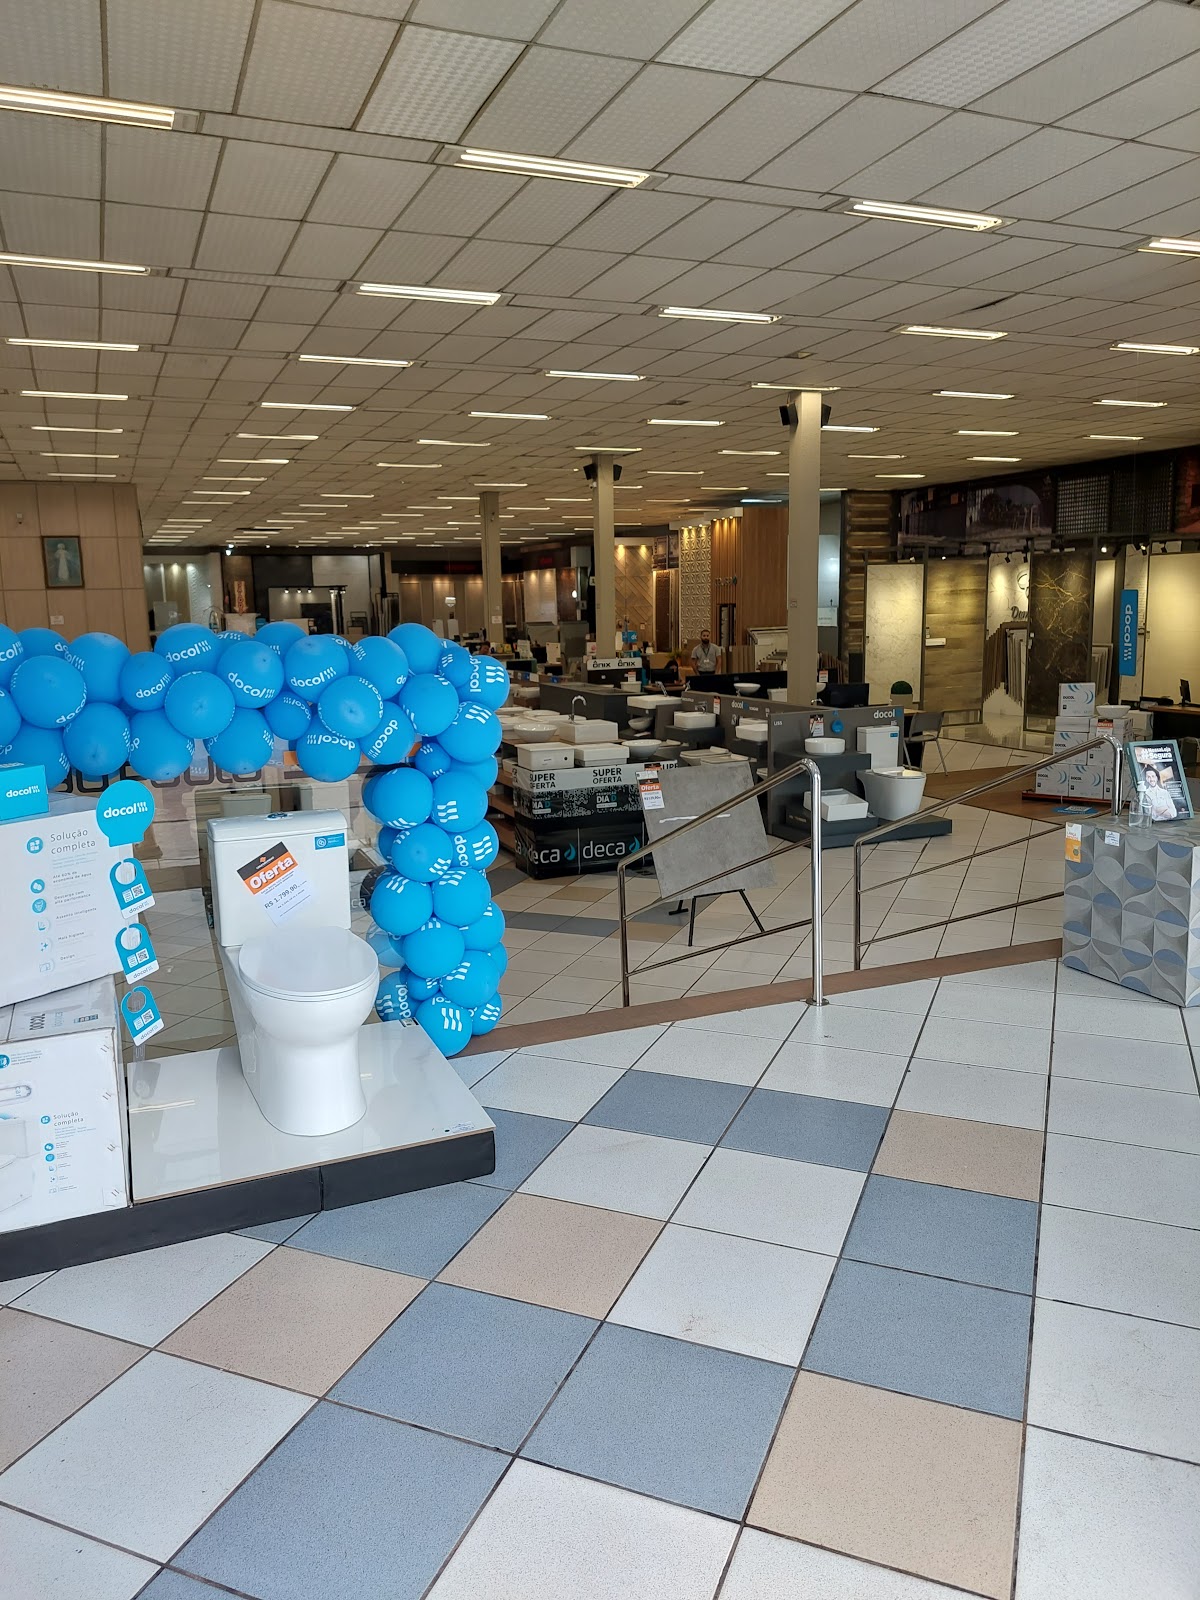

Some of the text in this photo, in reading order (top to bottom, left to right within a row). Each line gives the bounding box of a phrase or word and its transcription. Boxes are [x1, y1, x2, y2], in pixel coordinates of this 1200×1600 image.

[1123, 604, 1134, 647] docol
[165, 643, 201, 663] docol
[227, 672, 267, 698] docol
[290, 671, 326, 688] docol
[135, 678, 166, 699] docol
[873, 709, 896, 719] docol
[317, 734, 356, 750] docol
[371, 719, 399, 754] docol
[592, 776, 623, 785] OFERTA
[593, 767, 622, 778] SUPER
[5, 786, 32, 798] docol
[596, 795, 610, 804] DIA
[103, 802, 137, 819] docol
[50, 829, 88, 843] Solução
[51, 840, 96, 855] completa
[454, 835, 469, 867] doco
[528, 844, 560, 864] deca
[582, 840, 626, 859] deca
[249, 857, 294, 889] Oferta
[129, 903, 144, 914] docol
[133, 967, 149, 979] docol
[53, 1111, 79, 1120] Solução
[53, 1117, 84, 1127] completa
